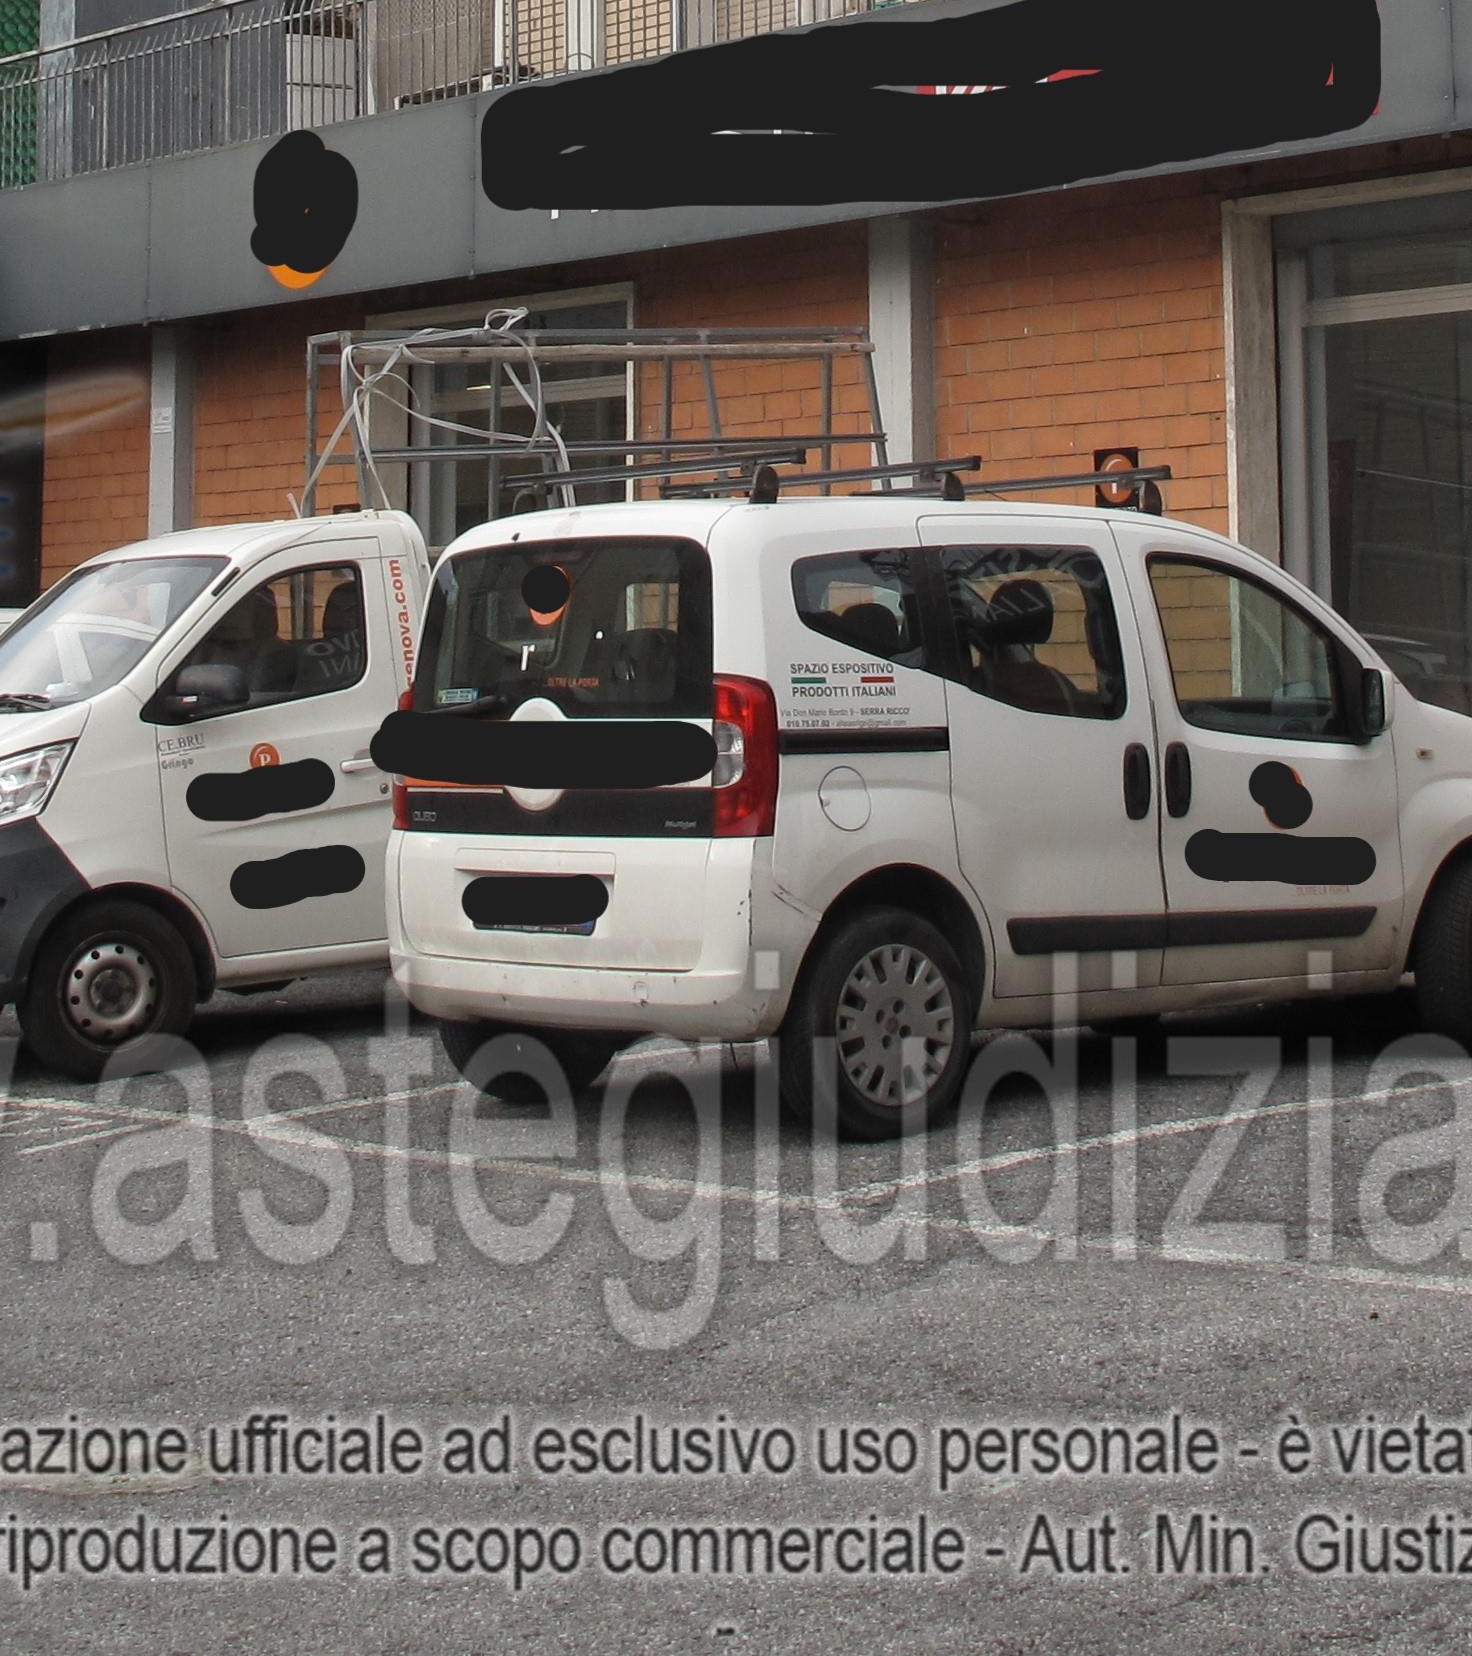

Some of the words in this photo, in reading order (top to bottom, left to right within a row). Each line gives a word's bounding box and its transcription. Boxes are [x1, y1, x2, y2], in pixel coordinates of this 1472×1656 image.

[790, 663, 829, 674] SPAZIO
[831, 663, 894, 674] ESPOSITIVO
[792, 686, 848, 697] PRODOTTI
[852, 685, 896, 697] ITALIANI
